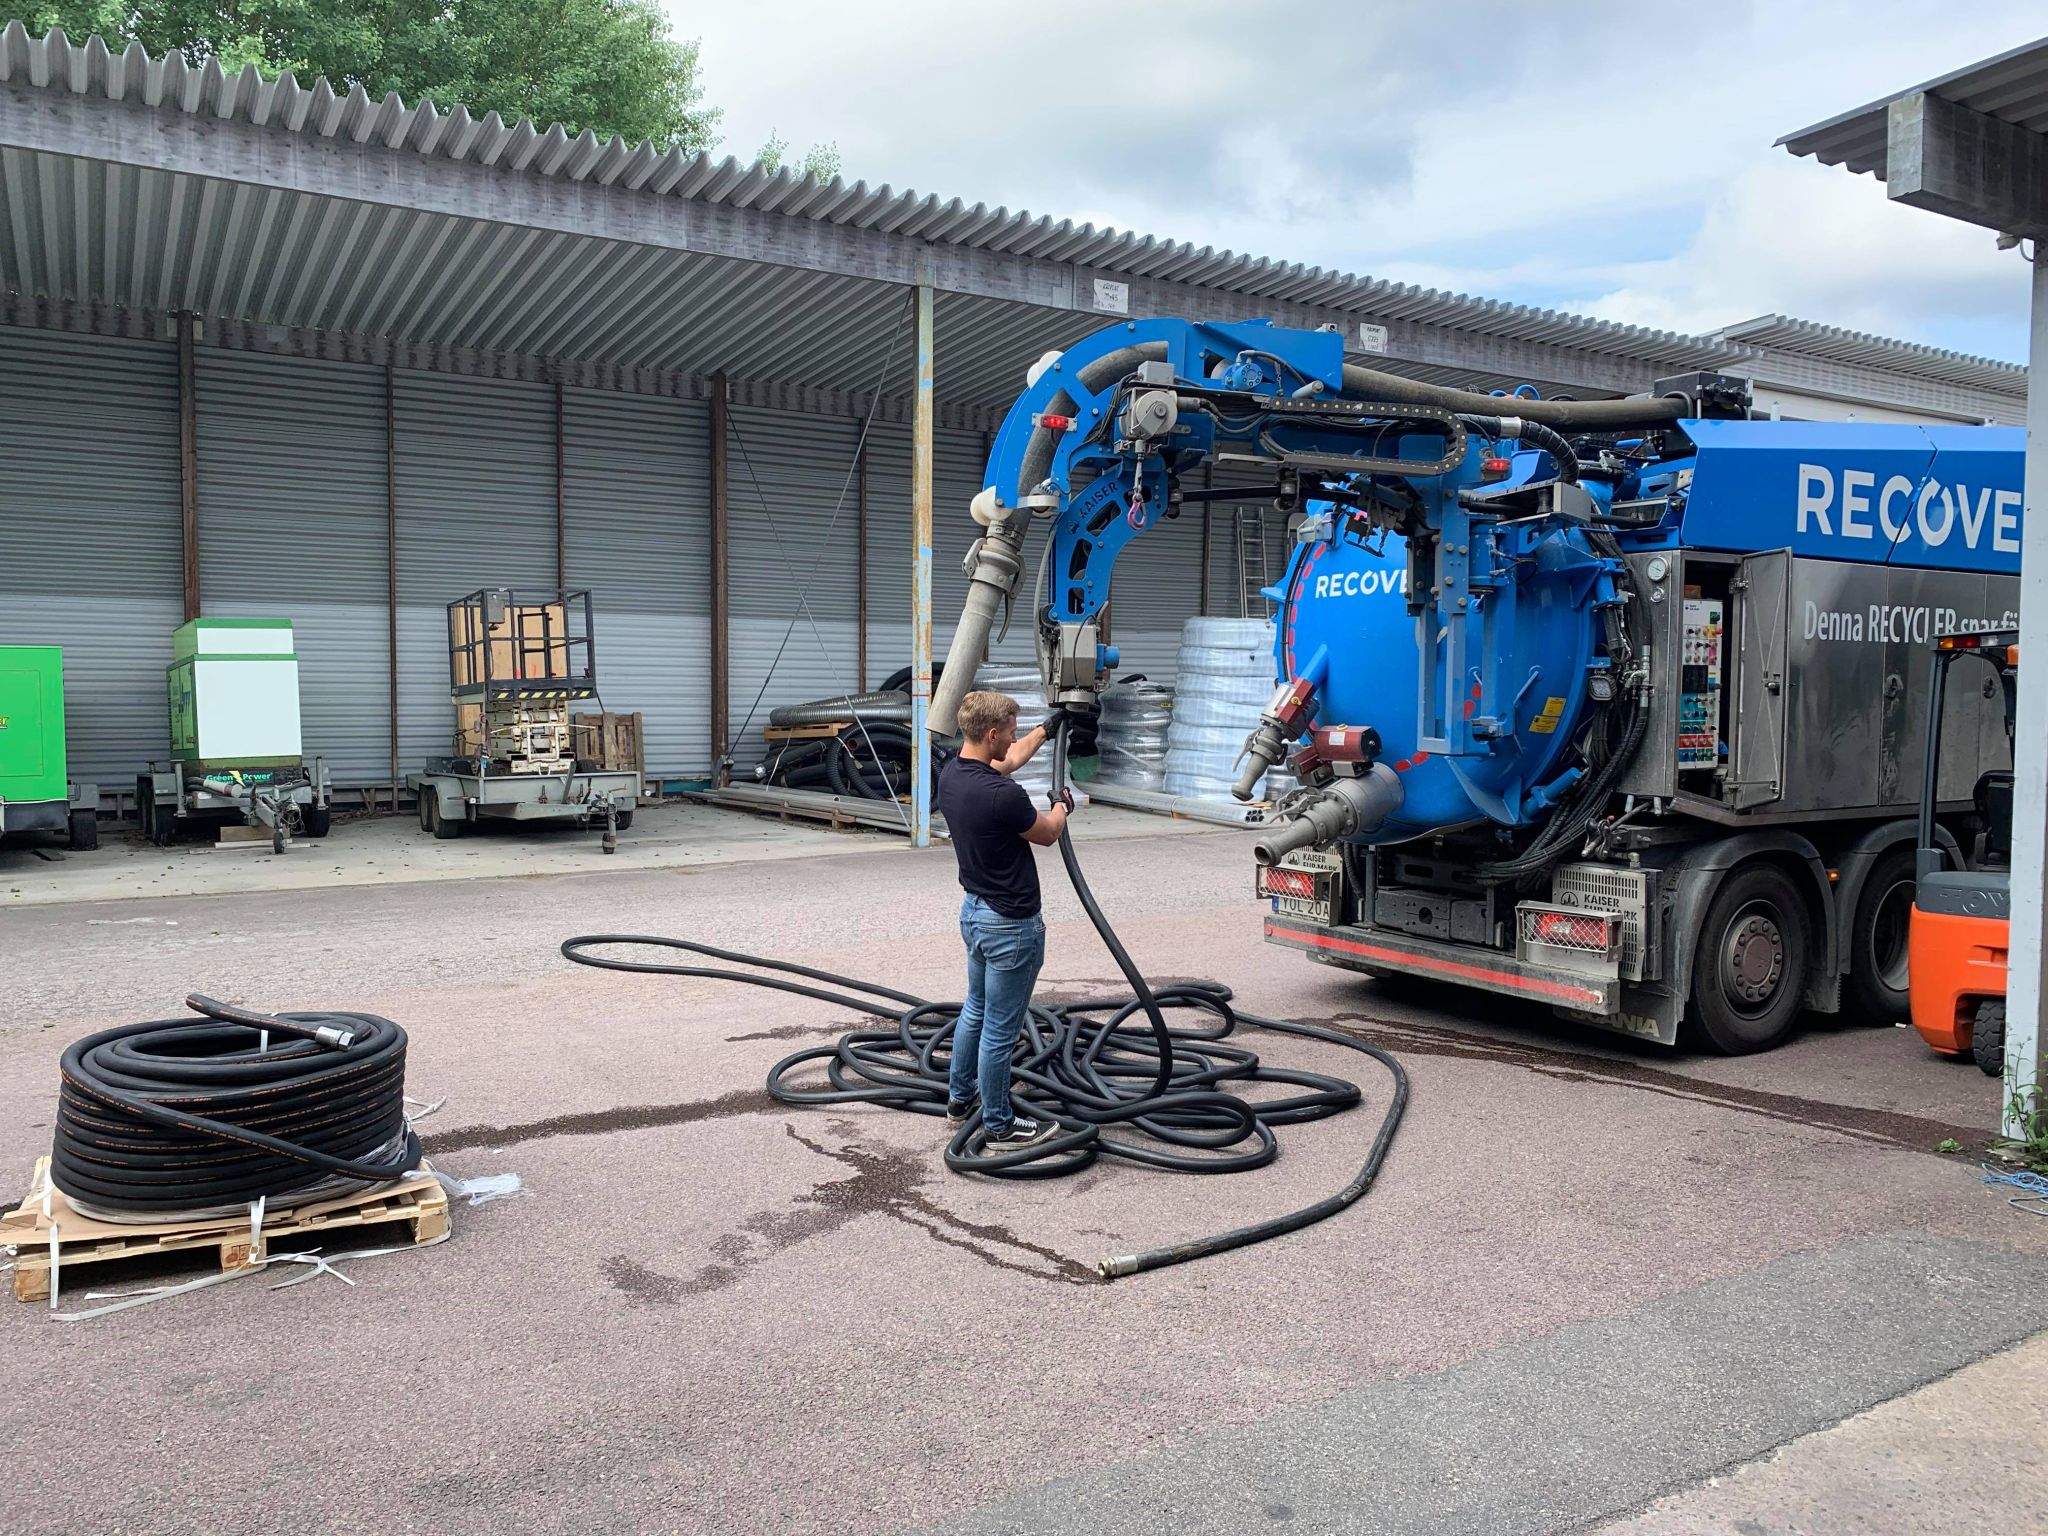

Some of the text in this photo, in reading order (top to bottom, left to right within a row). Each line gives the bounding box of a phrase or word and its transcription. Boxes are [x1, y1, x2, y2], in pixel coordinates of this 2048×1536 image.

[1080, 481, 1117, 519] KAISER
[1797, 463, 2022, 553] RECOVE
[1804, 600, 1863, 642] Denna
[1302, 853, 1326, 863] KAISER
[1584, 894, 1620, 908] KAISER
